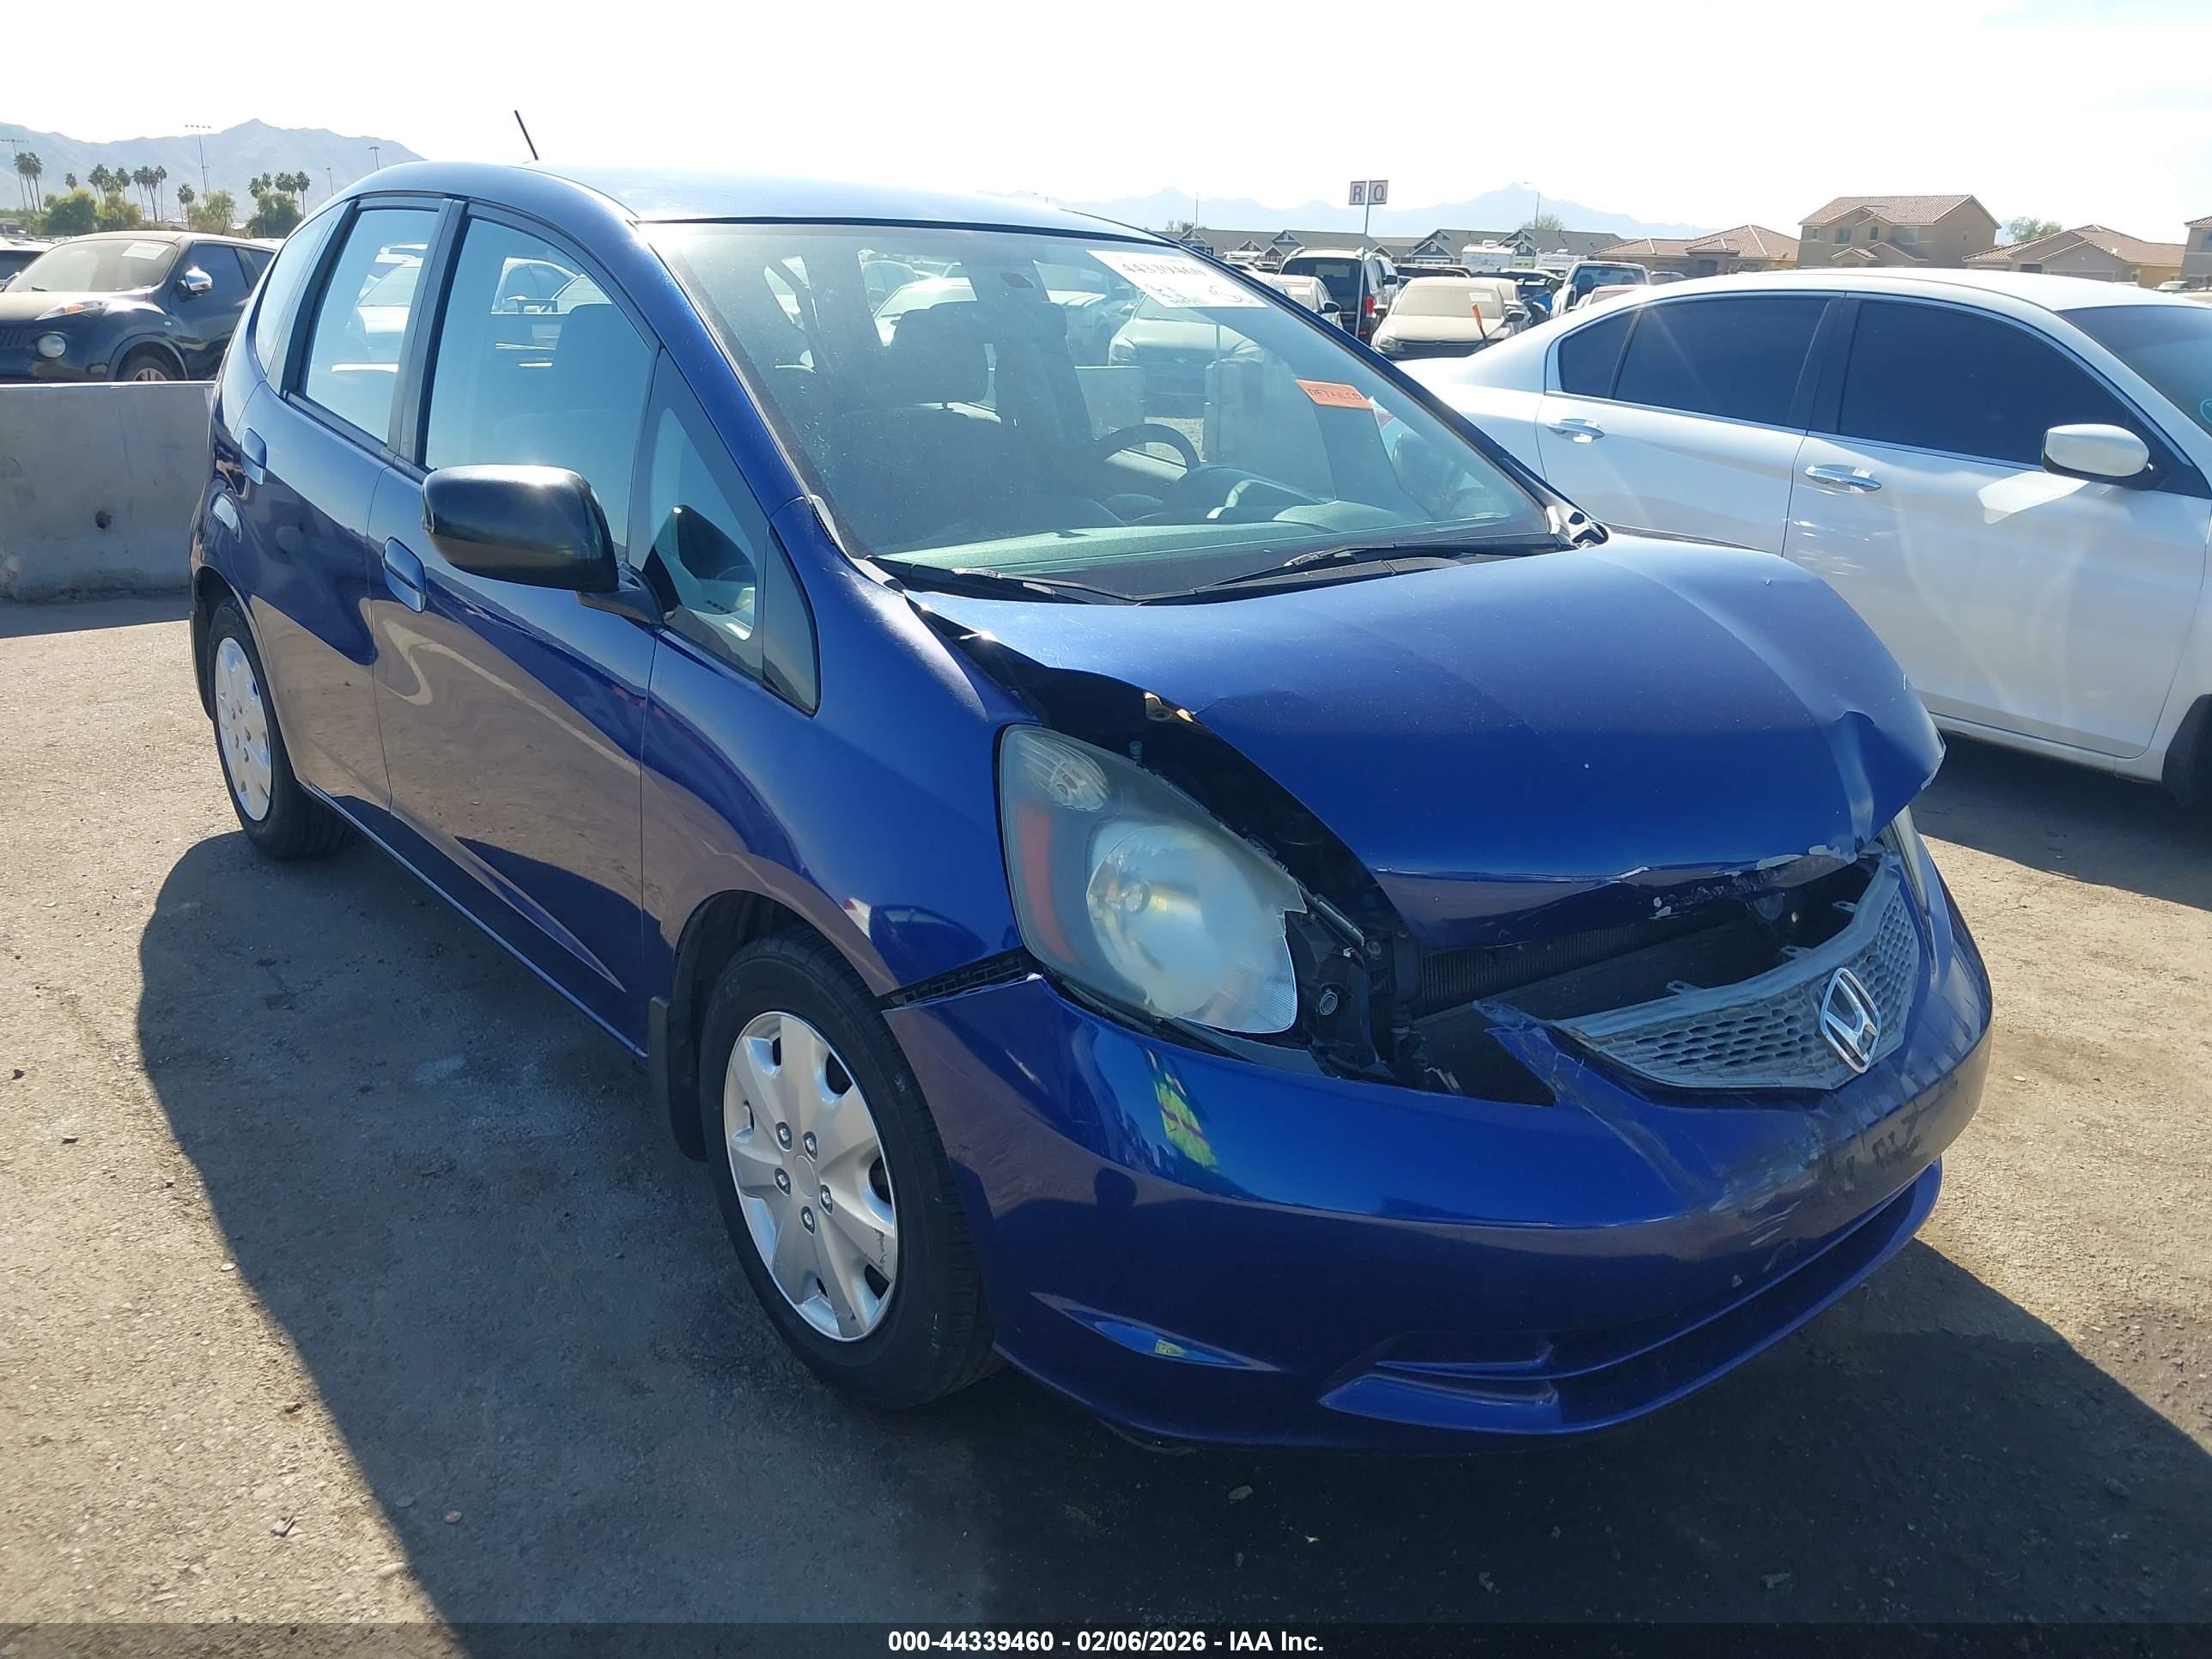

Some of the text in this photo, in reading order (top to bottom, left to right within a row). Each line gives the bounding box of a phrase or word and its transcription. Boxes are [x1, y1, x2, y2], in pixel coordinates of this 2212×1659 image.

[1353, 185, 1362, 202] R
[1374, 185, 1384, 201] Q
[1307, 389, 1362, 400] DETAILED
